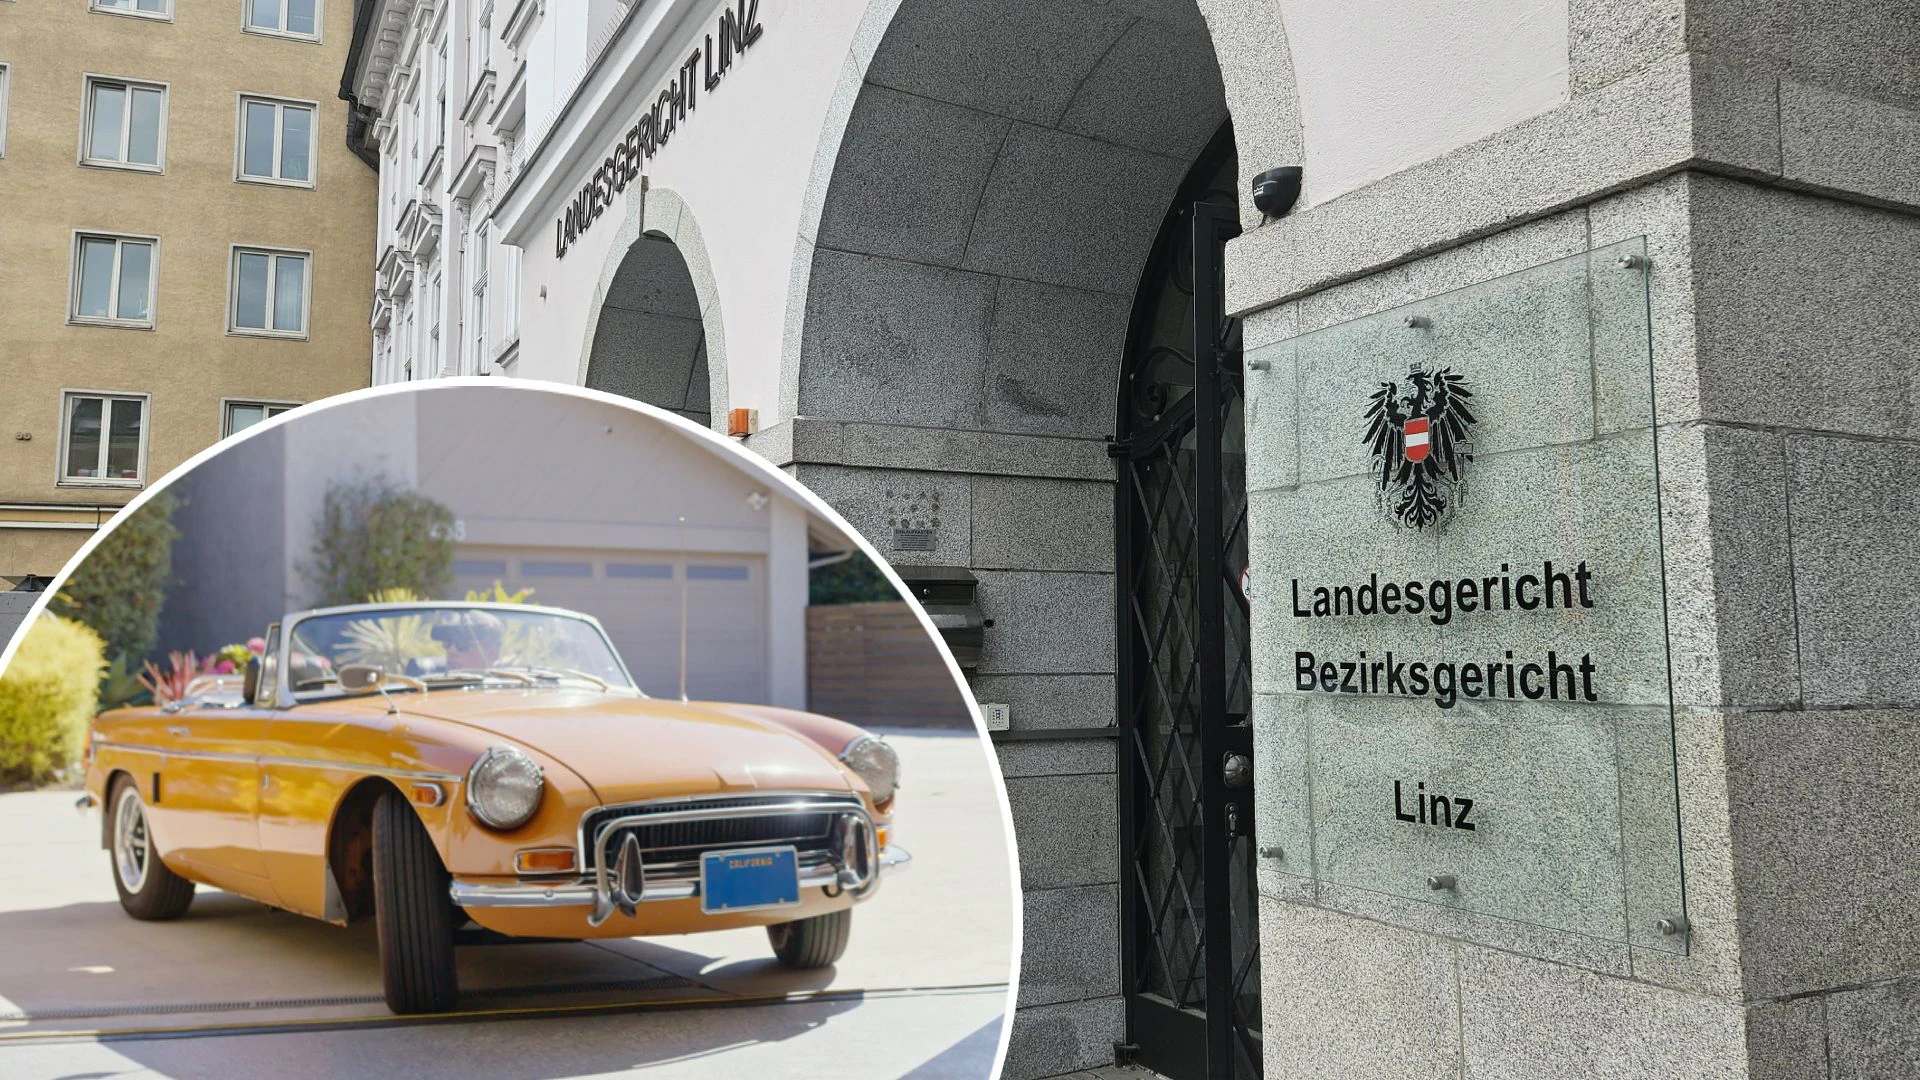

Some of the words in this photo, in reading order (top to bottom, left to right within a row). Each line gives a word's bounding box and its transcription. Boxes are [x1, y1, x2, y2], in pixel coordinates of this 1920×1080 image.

[556, 48, 701, 259] LANDESGERICHT
[705, 0, 763, 92] LINZ
[1292, 560, 1594, 625] Landesgericht
[1295, 650, 1597, 709] Bezirksgericht
[1394, 780, 1476, 831] Linz
[729, 857, 773, 869] CALIFORNIA
